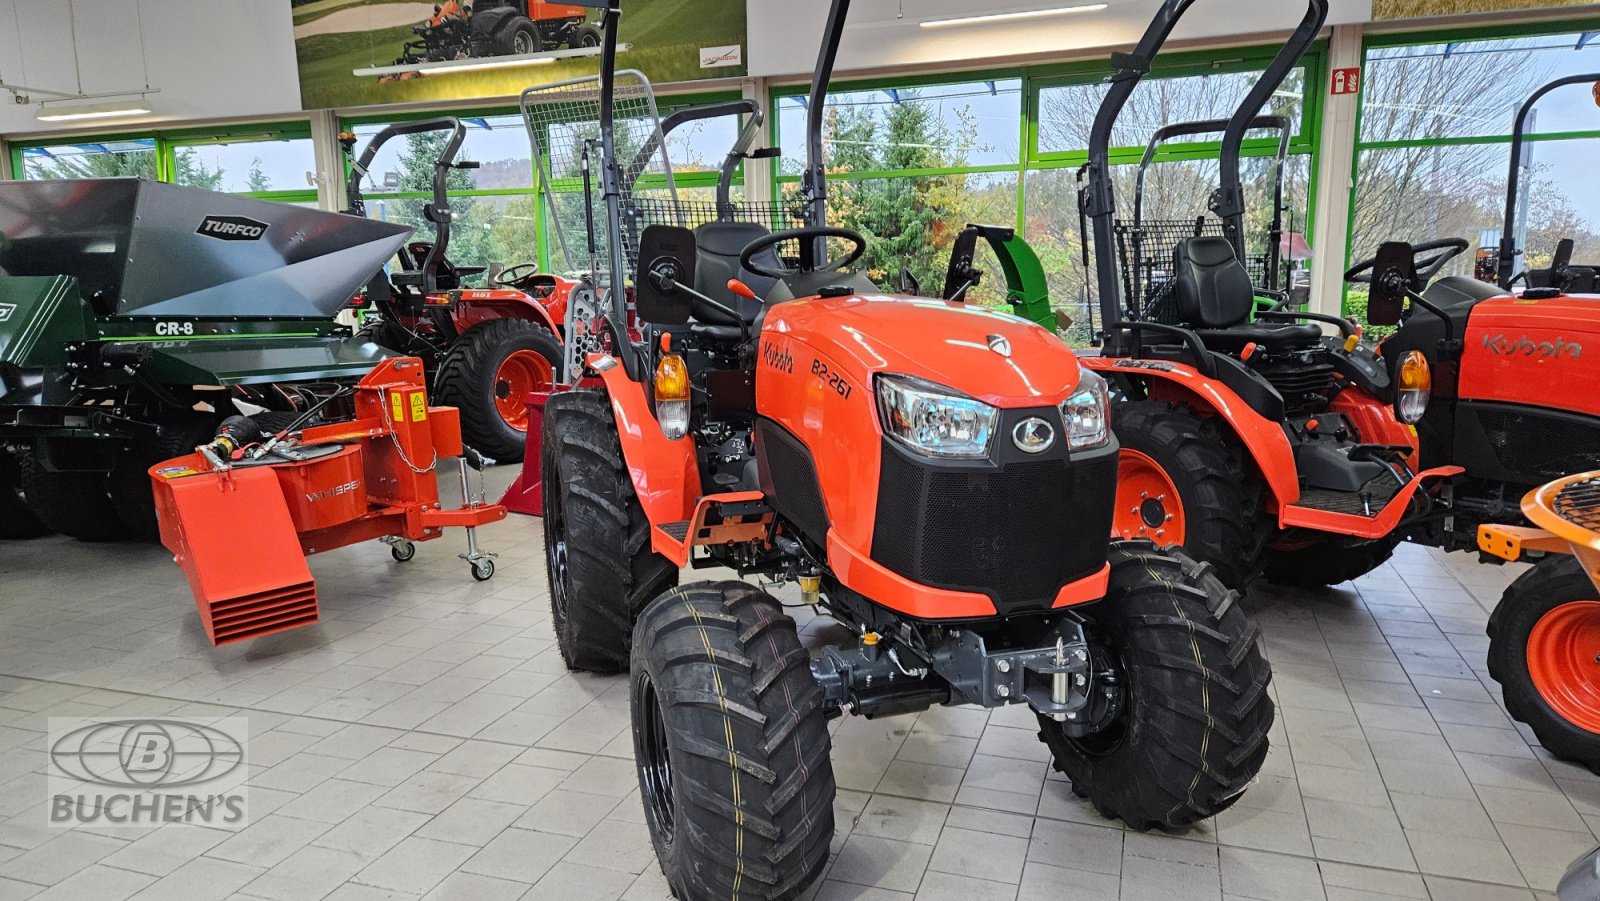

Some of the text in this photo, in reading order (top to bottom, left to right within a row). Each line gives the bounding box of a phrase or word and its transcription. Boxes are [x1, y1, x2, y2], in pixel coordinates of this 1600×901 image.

[205, 220, 262, 236] TURFCO
[155, 321, 194, 336] CR-8
[764, 340, 794, 375] Kubota
[1483, 334, 1583, 358] Kubota
[811, 358, 852, 400] B2-261
